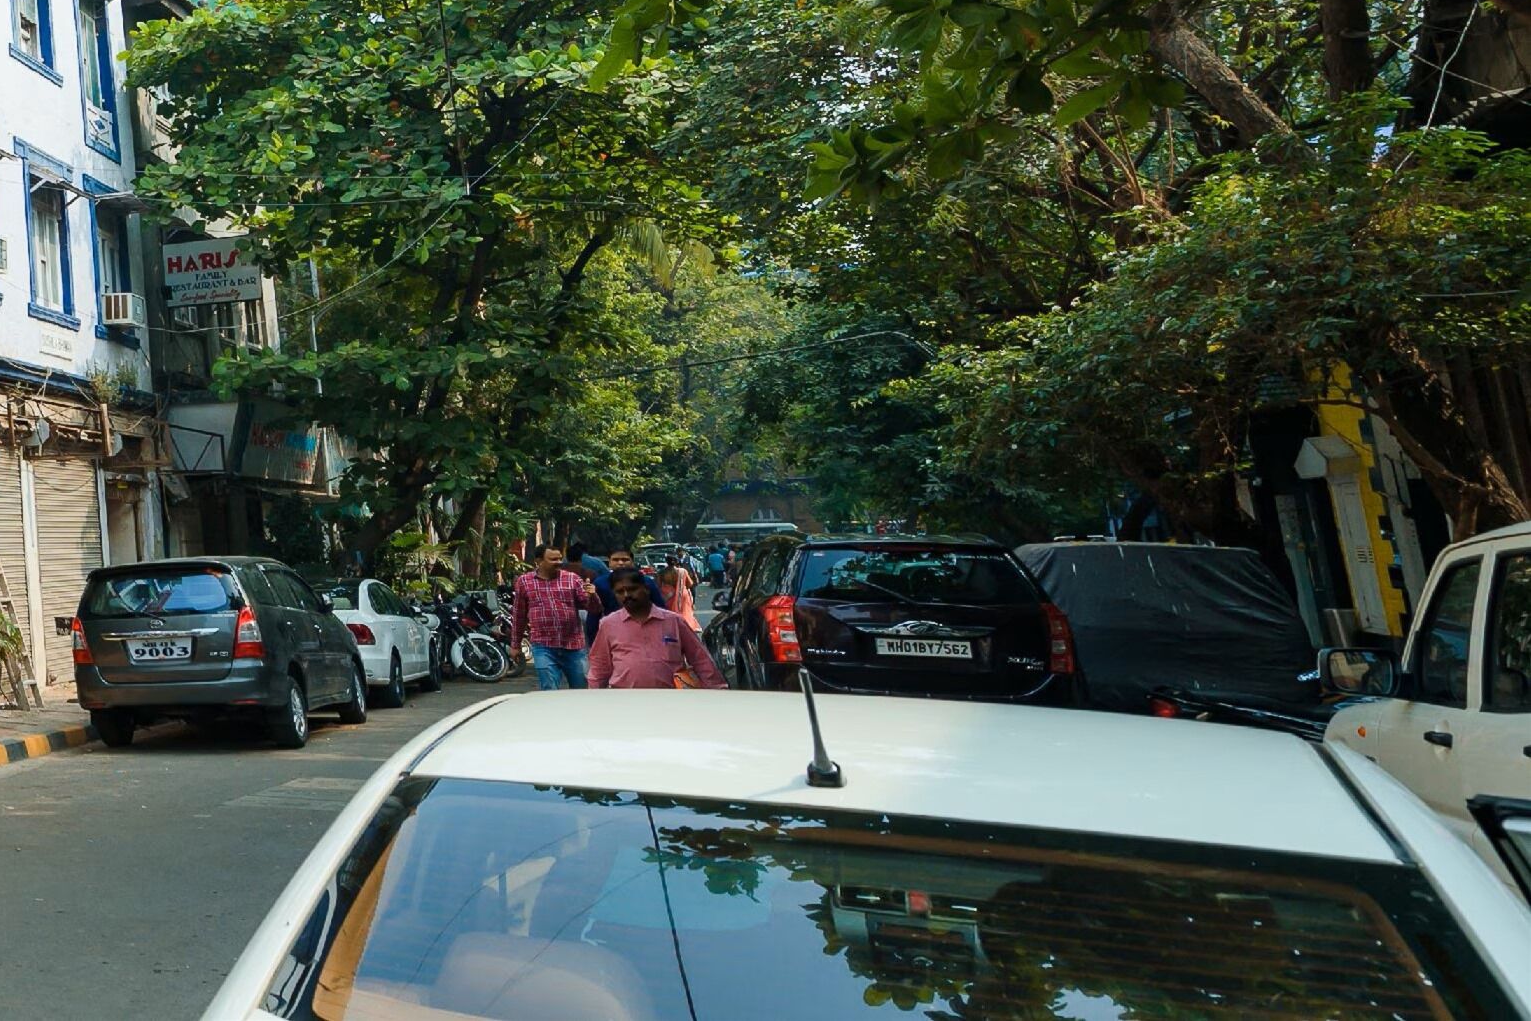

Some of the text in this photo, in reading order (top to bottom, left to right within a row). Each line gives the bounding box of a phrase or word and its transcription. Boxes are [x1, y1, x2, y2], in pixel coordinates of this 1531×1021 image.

[195, 270, 229, 281] FAMILY
[172, 277, 257, 293] RESTAURANT & BAR
[134, 646, 190, 658] 9003
[886, 640, 969, 656] MH01BY7562
